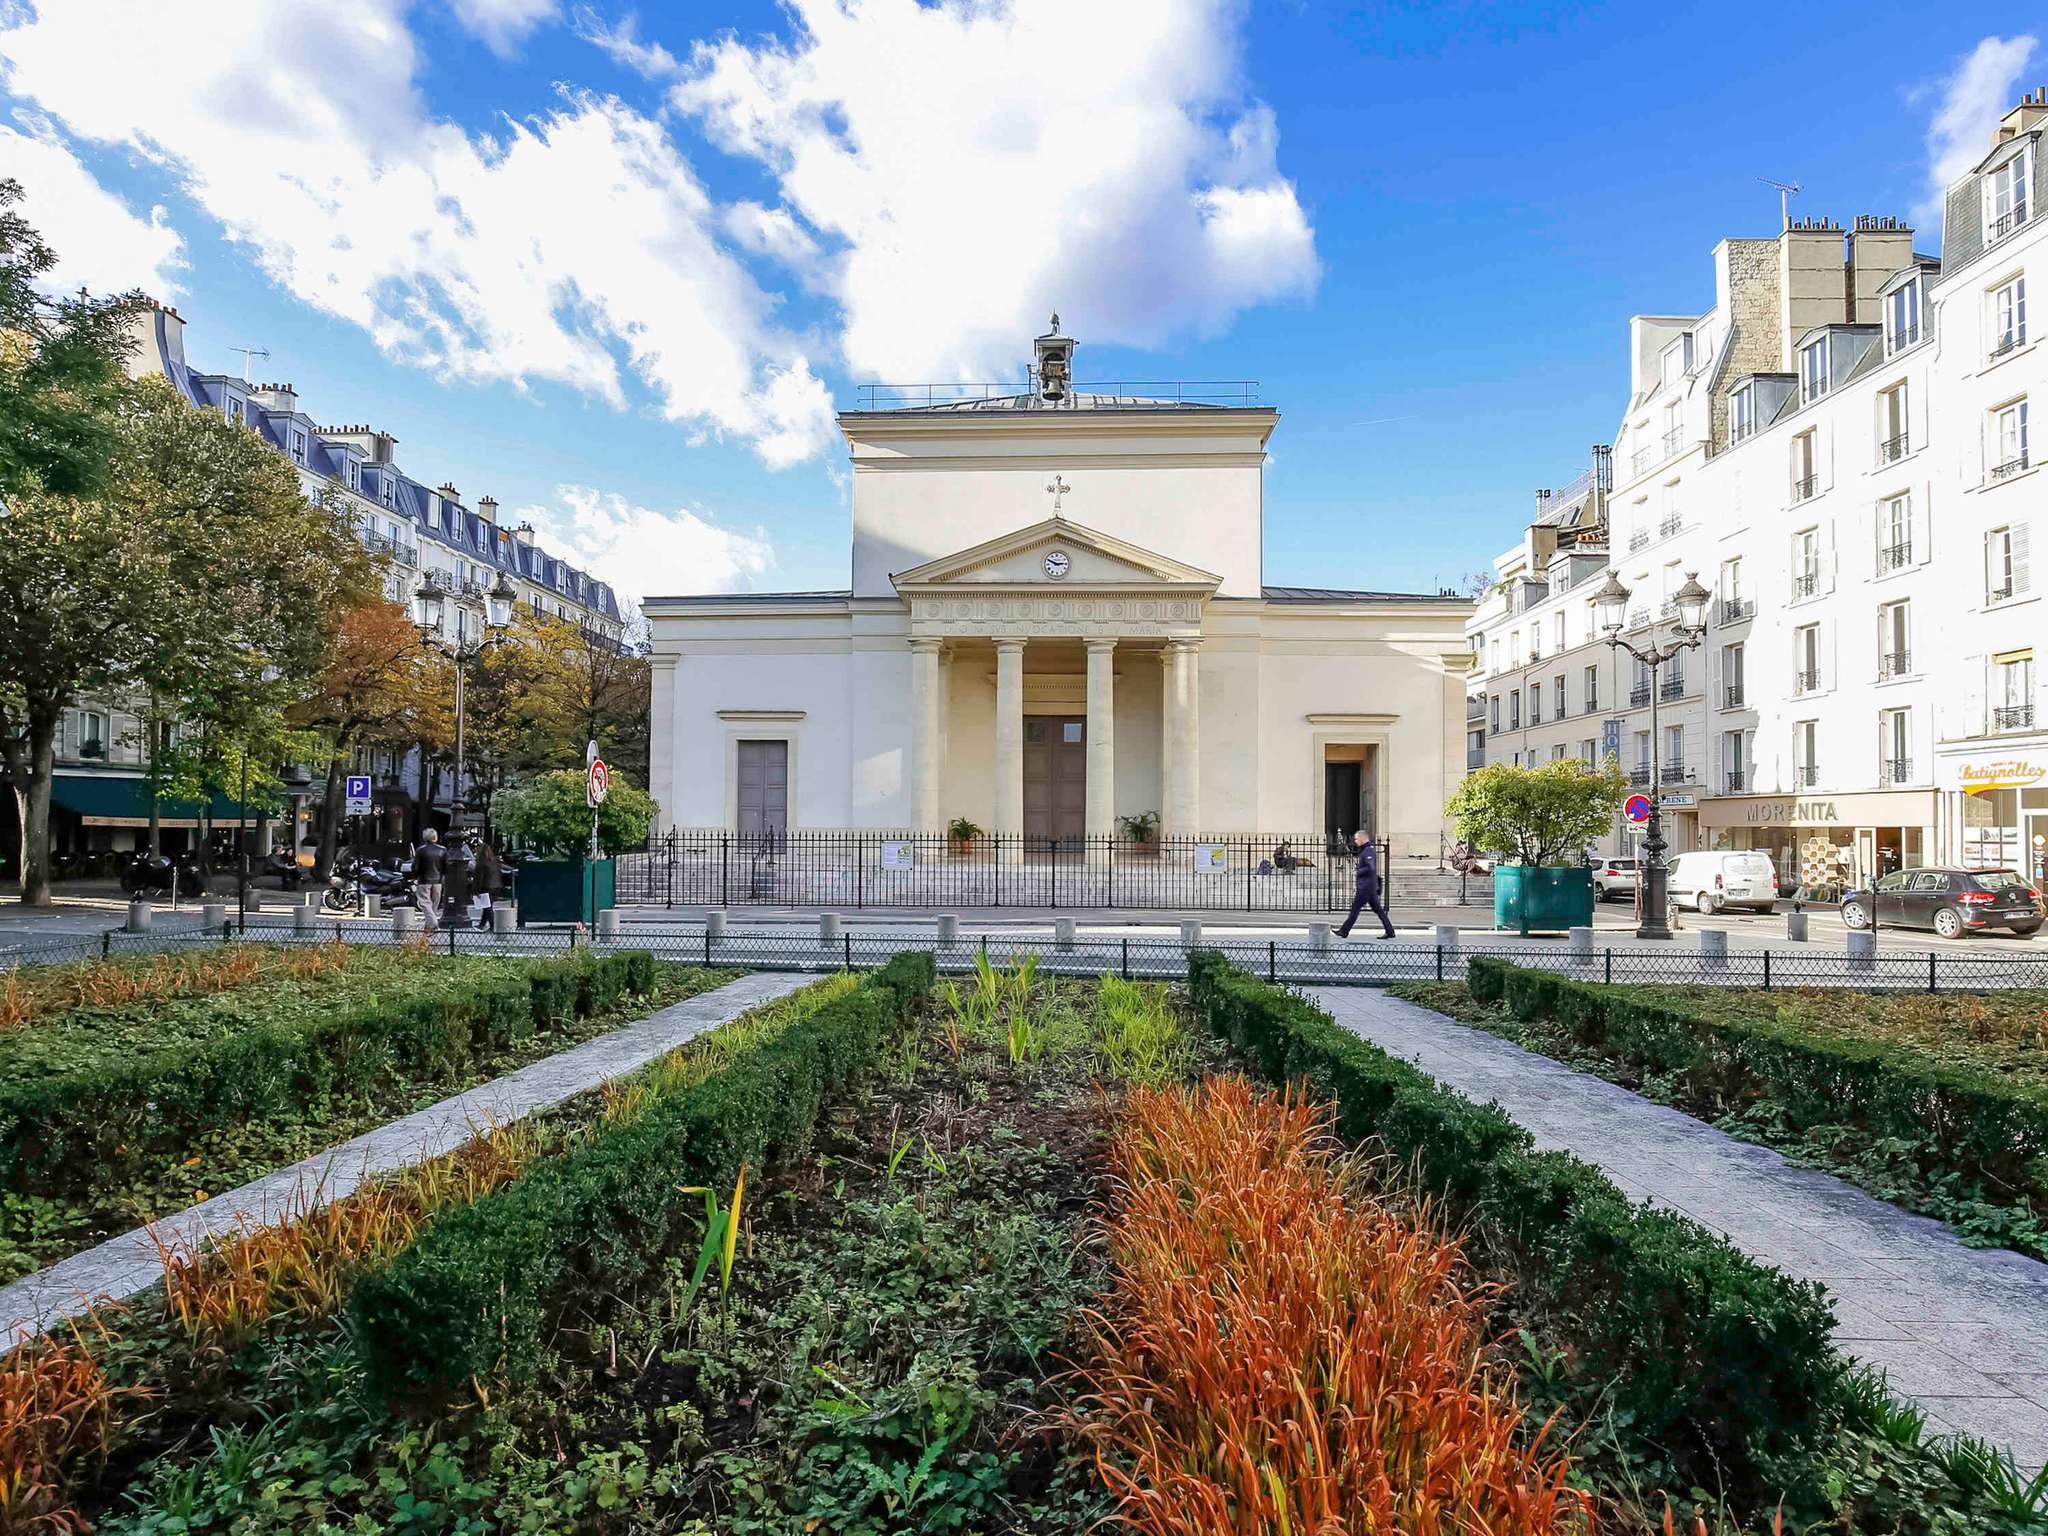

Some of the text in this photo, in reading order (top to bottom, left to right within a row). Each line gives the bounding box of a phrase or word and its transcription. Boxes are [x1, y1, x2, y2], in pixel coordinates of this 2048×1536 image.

[1960, 761, 2046, 783] Batignolles
[353, 781, 364, 795] P
[1746, 802, 1839, 821] MORENITA
